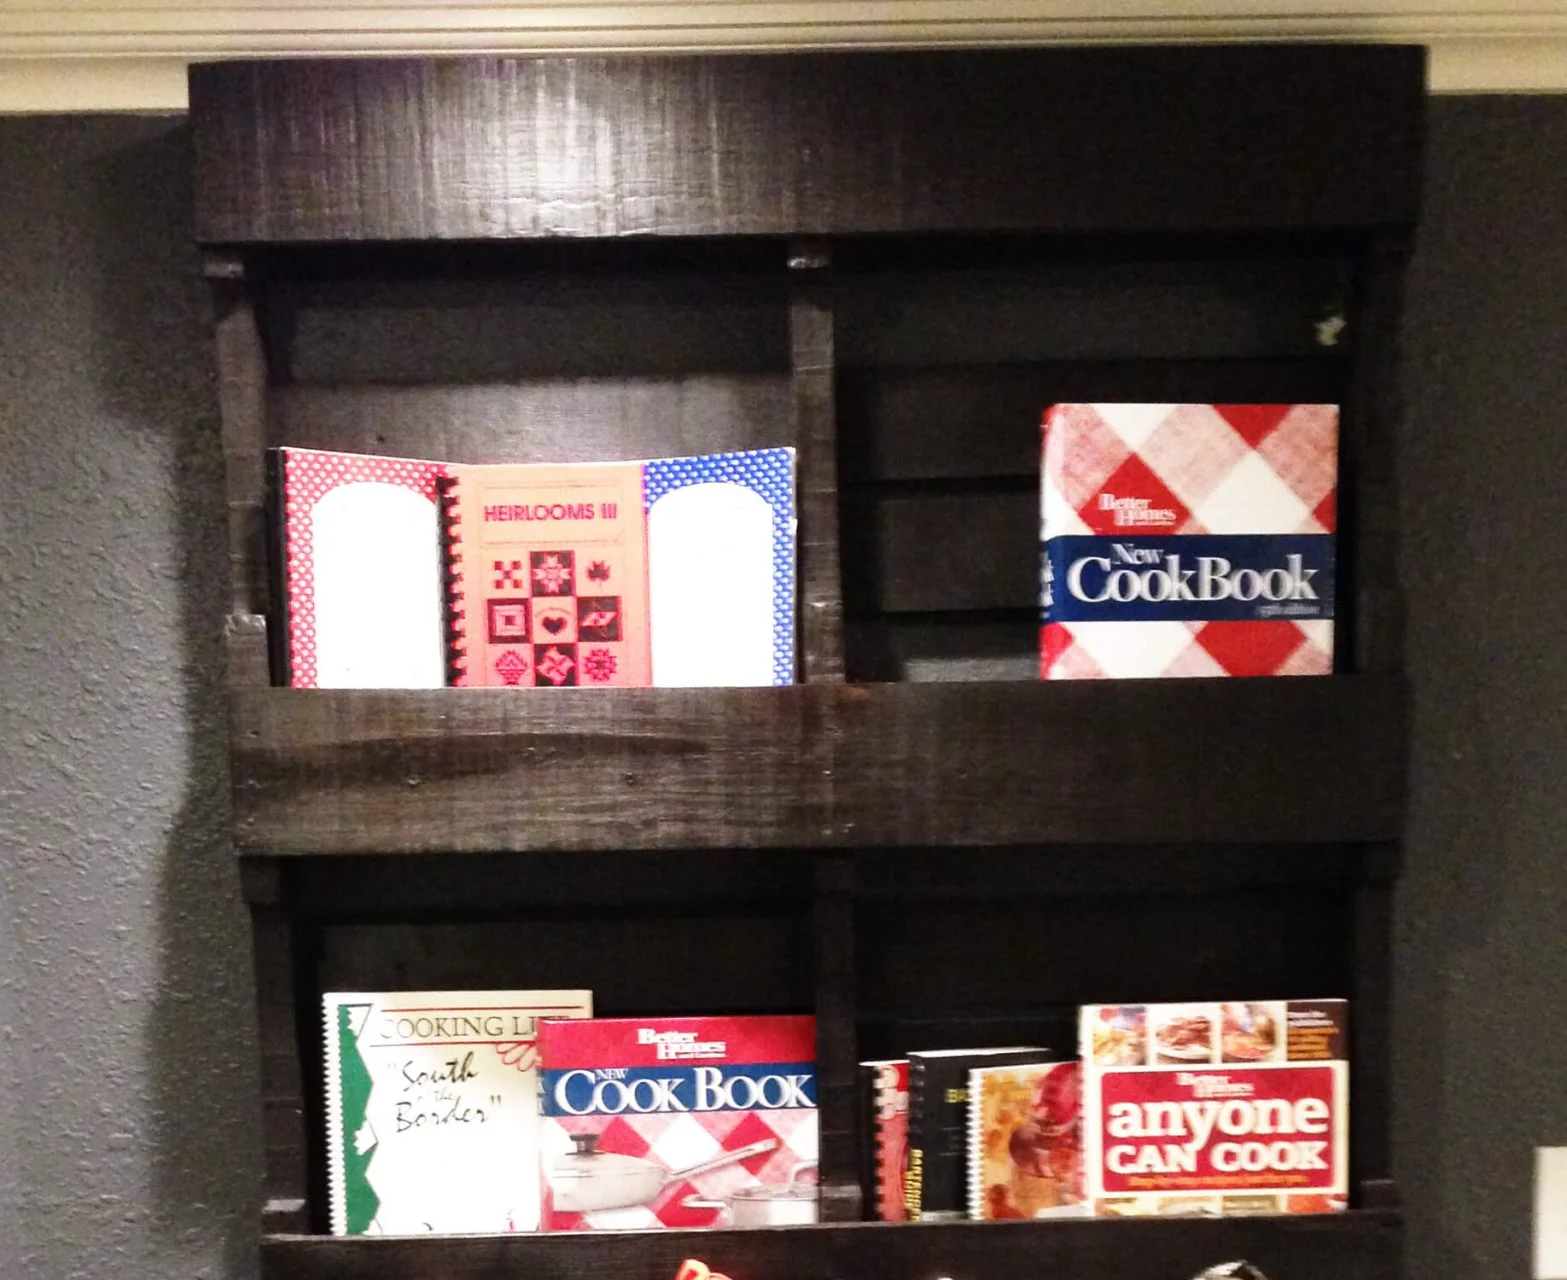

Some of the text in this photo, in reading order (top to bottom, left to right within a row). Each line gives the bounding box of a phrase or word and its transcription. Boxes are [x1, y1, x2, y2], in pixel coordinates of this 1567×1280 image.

[484, 502, 618, 522] HEIRLOOMS III
[1111, 543, 1164, 565] New
[379, 1016, 504, 1039] COOKING
[638, 1028, 699, 1045] Better
[595, 1067, 629, 1080] NEW
[1107, 1097, 1330, 1151] anyone
[1106, 1140, 1329, 1174] CAN COOK
